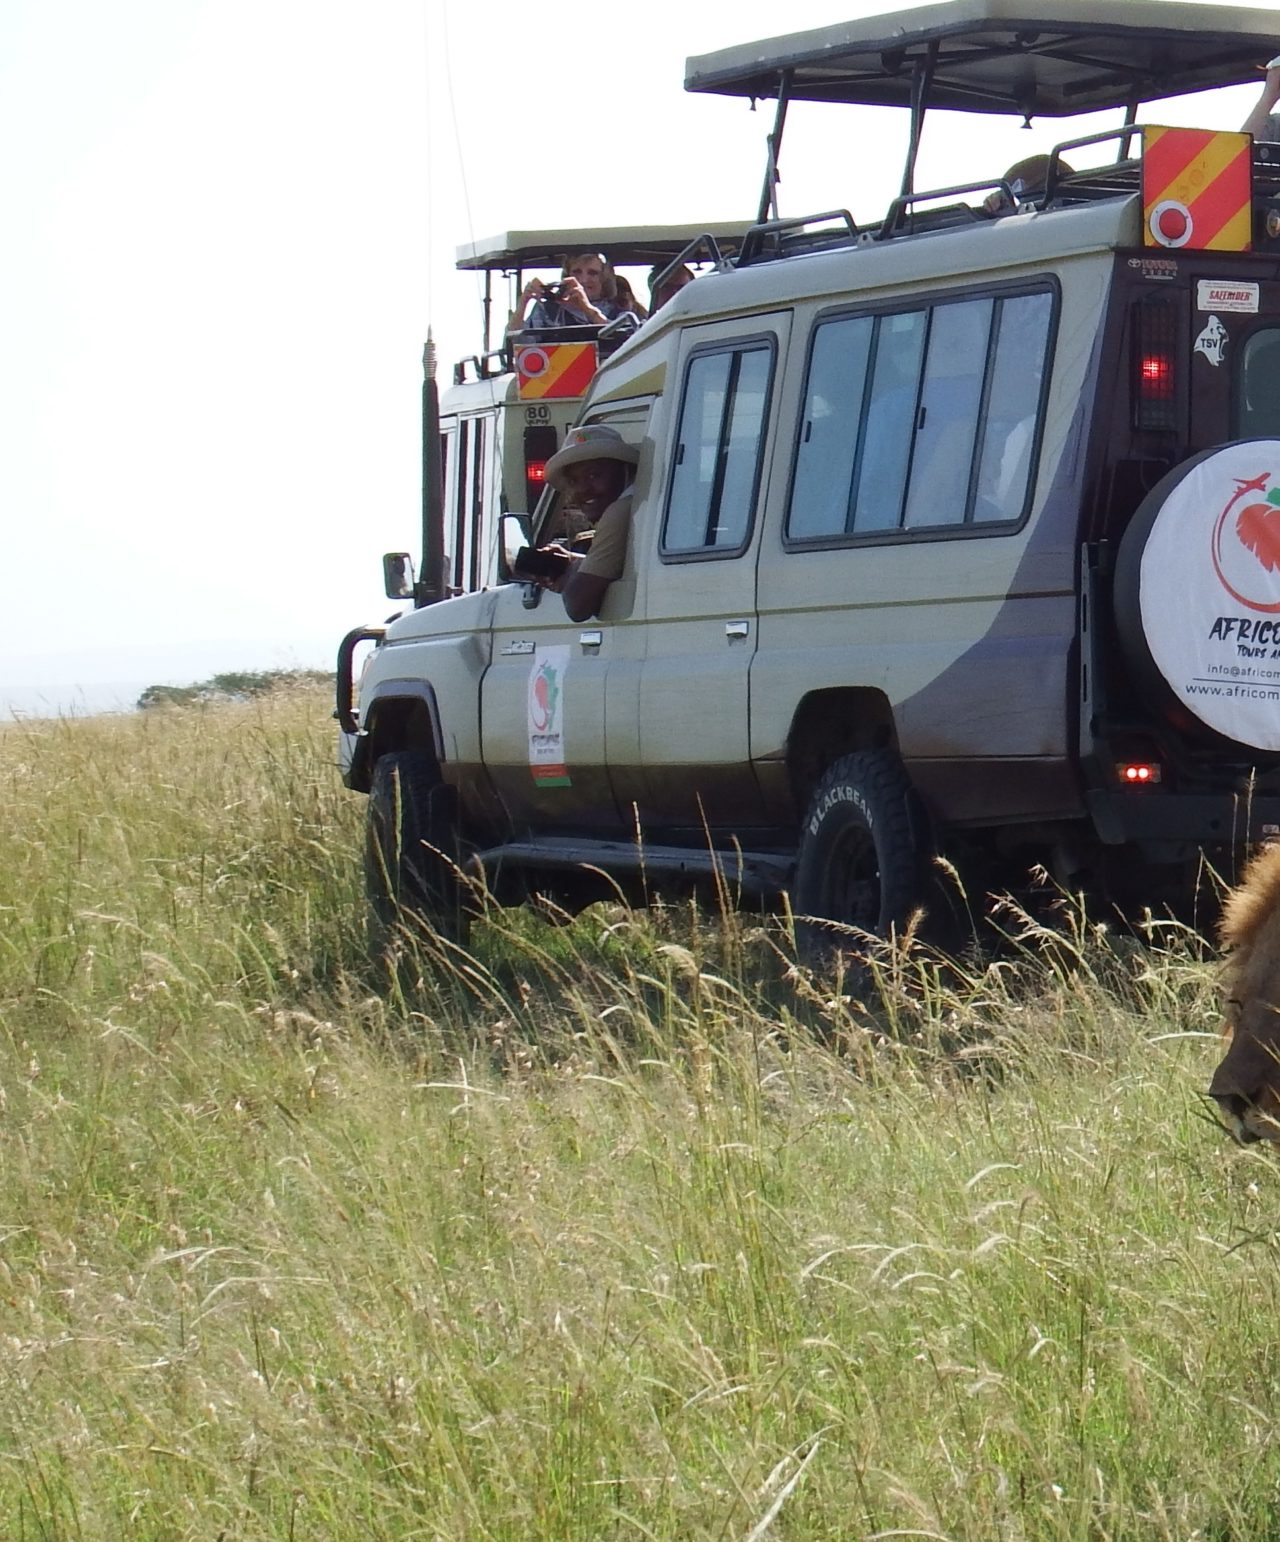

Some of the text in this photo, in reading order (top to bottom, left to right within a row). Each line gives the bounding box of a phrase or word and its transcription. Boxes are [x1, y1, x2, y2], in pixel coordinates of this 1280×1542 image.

[1200, 338, 1218, 349] TSV
[528, 406, 548, 419] 80
[1237, 644, 1267, 658] TOURS
